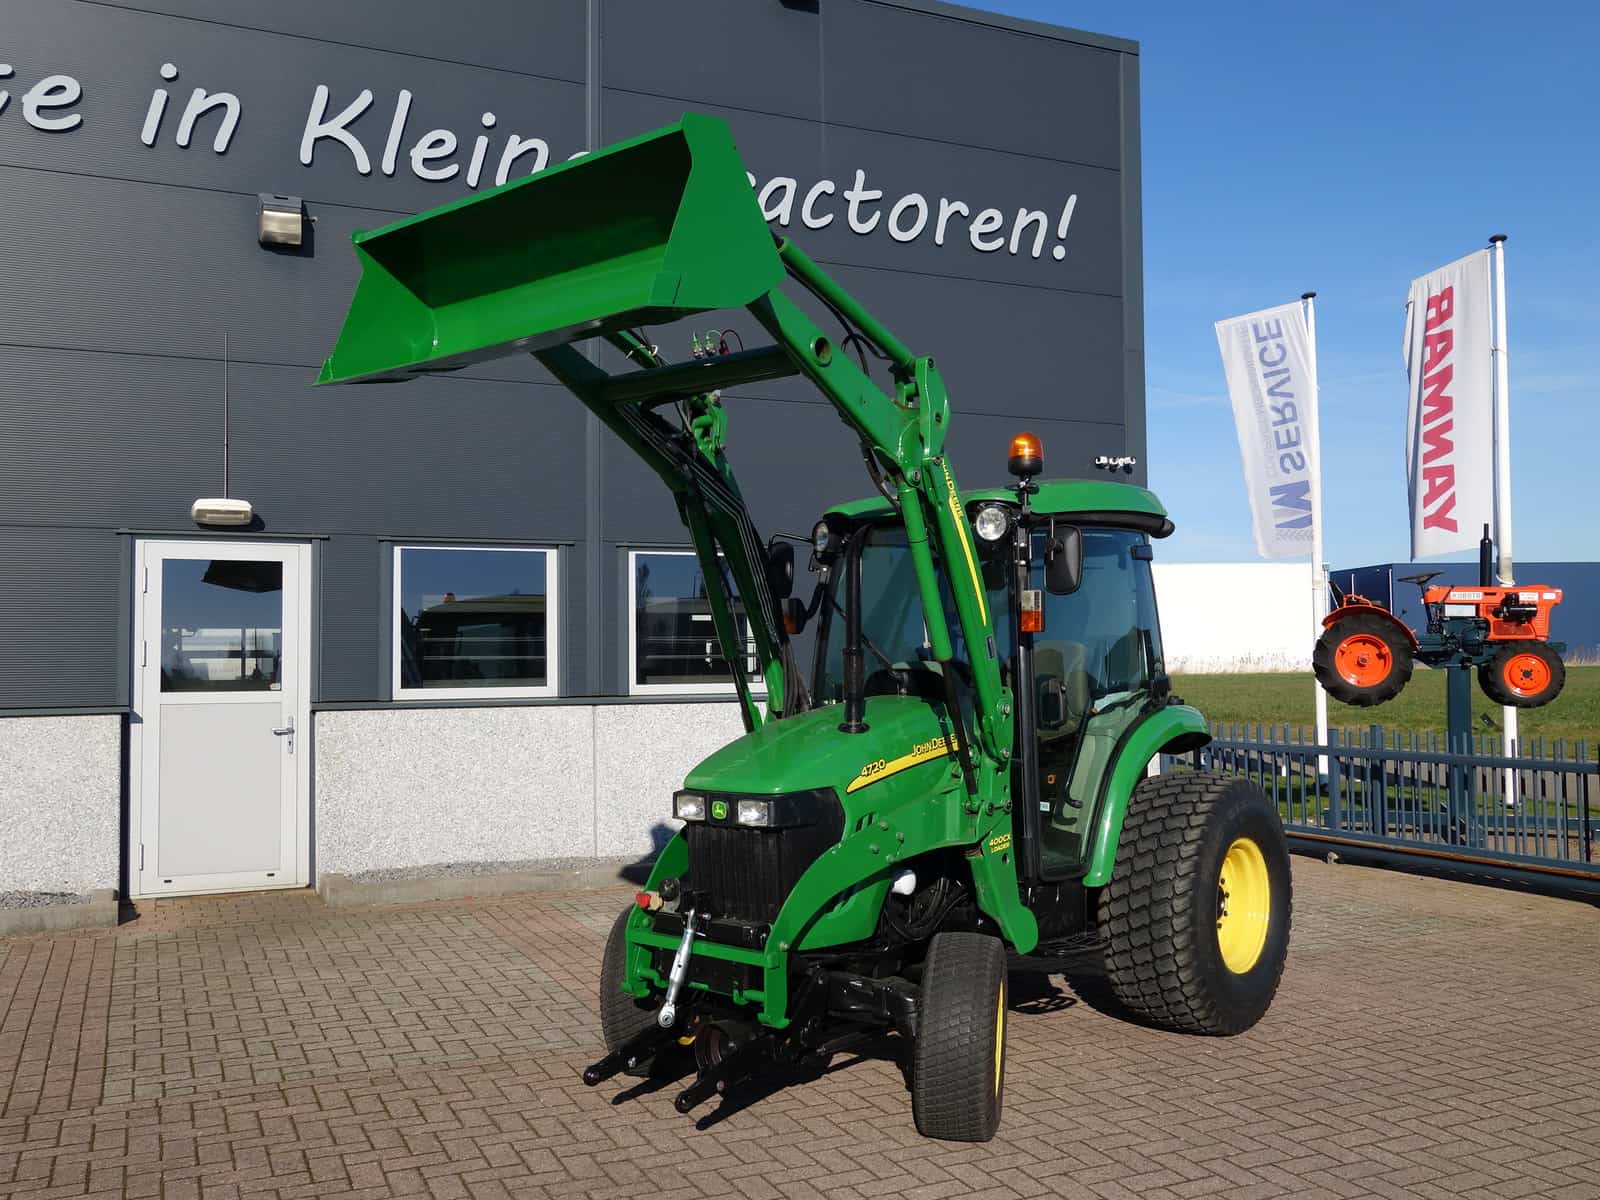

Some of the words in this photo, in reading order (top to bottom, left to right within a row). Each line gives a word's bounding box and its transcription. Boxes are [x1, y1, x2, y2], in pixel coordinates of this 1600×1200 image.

[140, 62, 240, 152] in
[300, 84, 590, 187] Klein
[911, 740, 933, 757] JOHN
[861, 759, 886, 777] 4720
